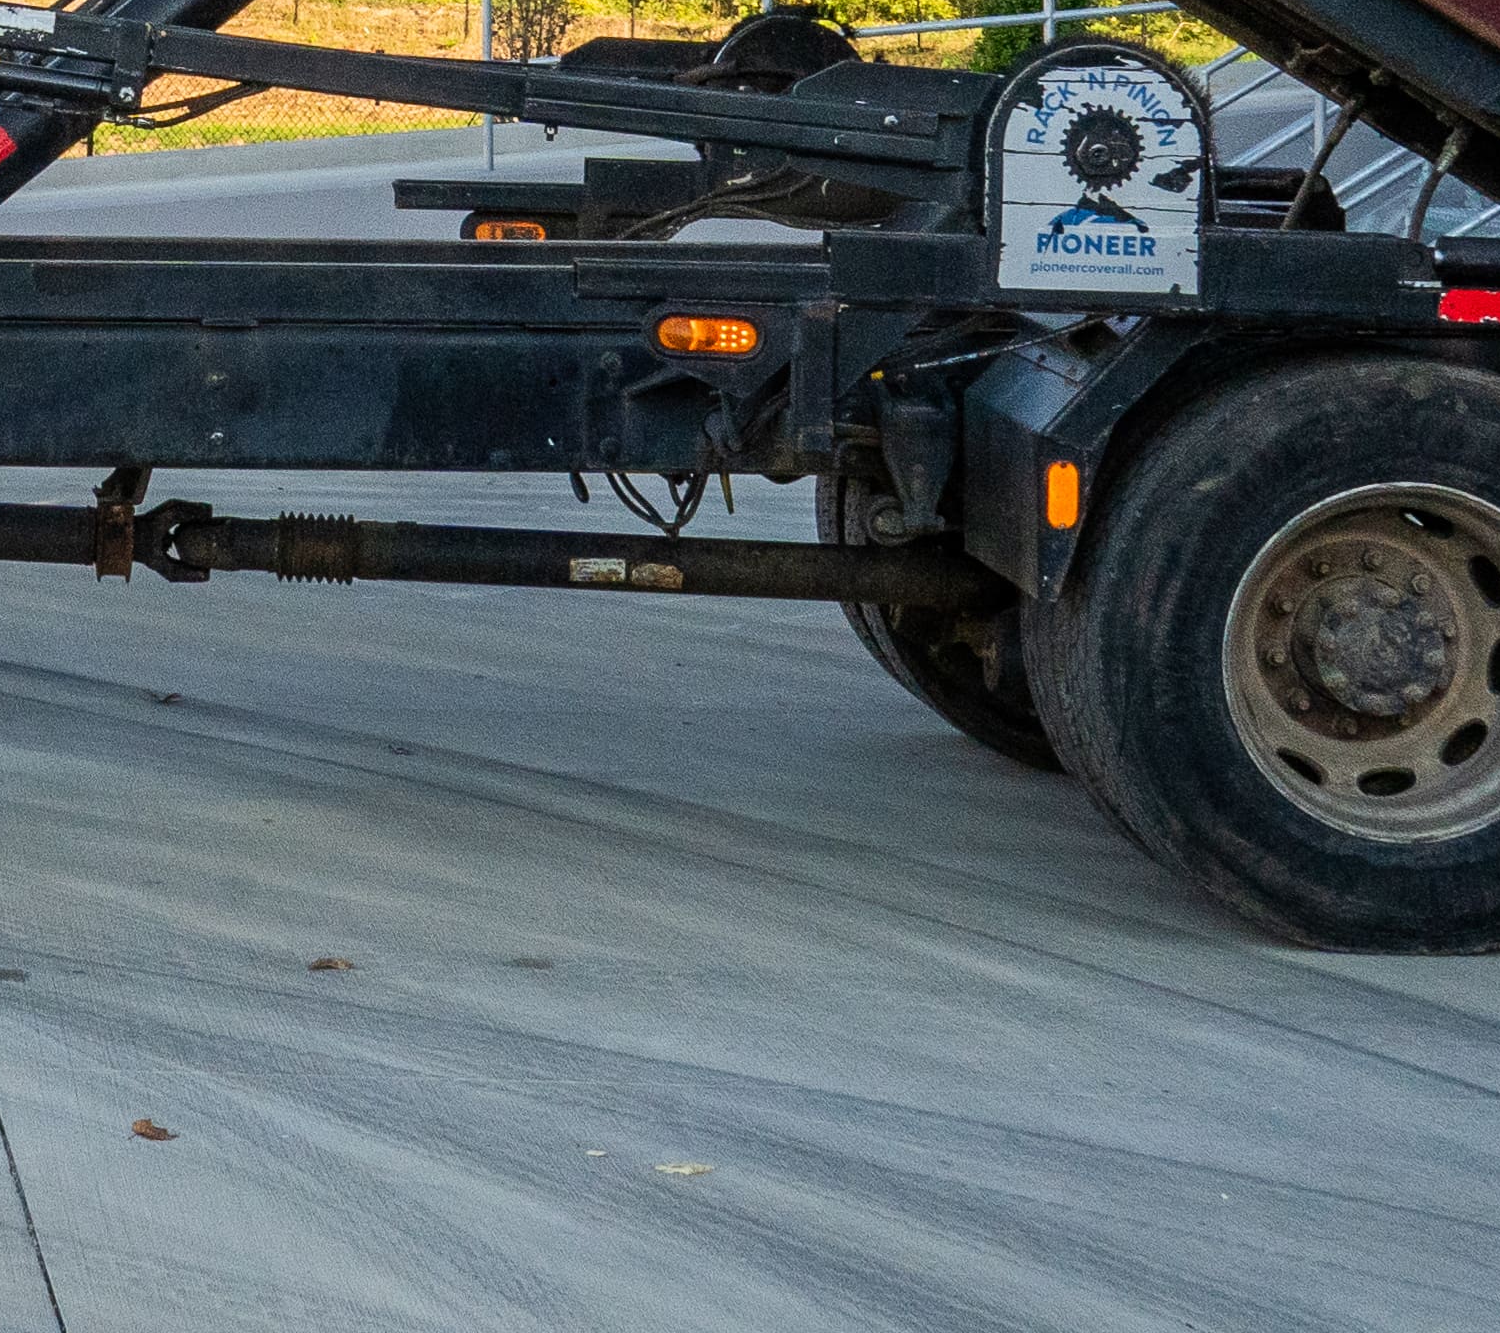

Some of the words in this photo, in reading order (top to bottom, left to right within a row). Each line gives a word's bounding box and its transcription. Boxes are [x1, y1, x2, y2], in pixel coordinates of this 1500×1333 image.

[1027, 85, 1079, 145] RACK
[1112, 74, 1177, 147] PINION
[1037, 232, 1157, 257] PIONEER
[1030, 261, 1165, 277] pioneercoverall.com
